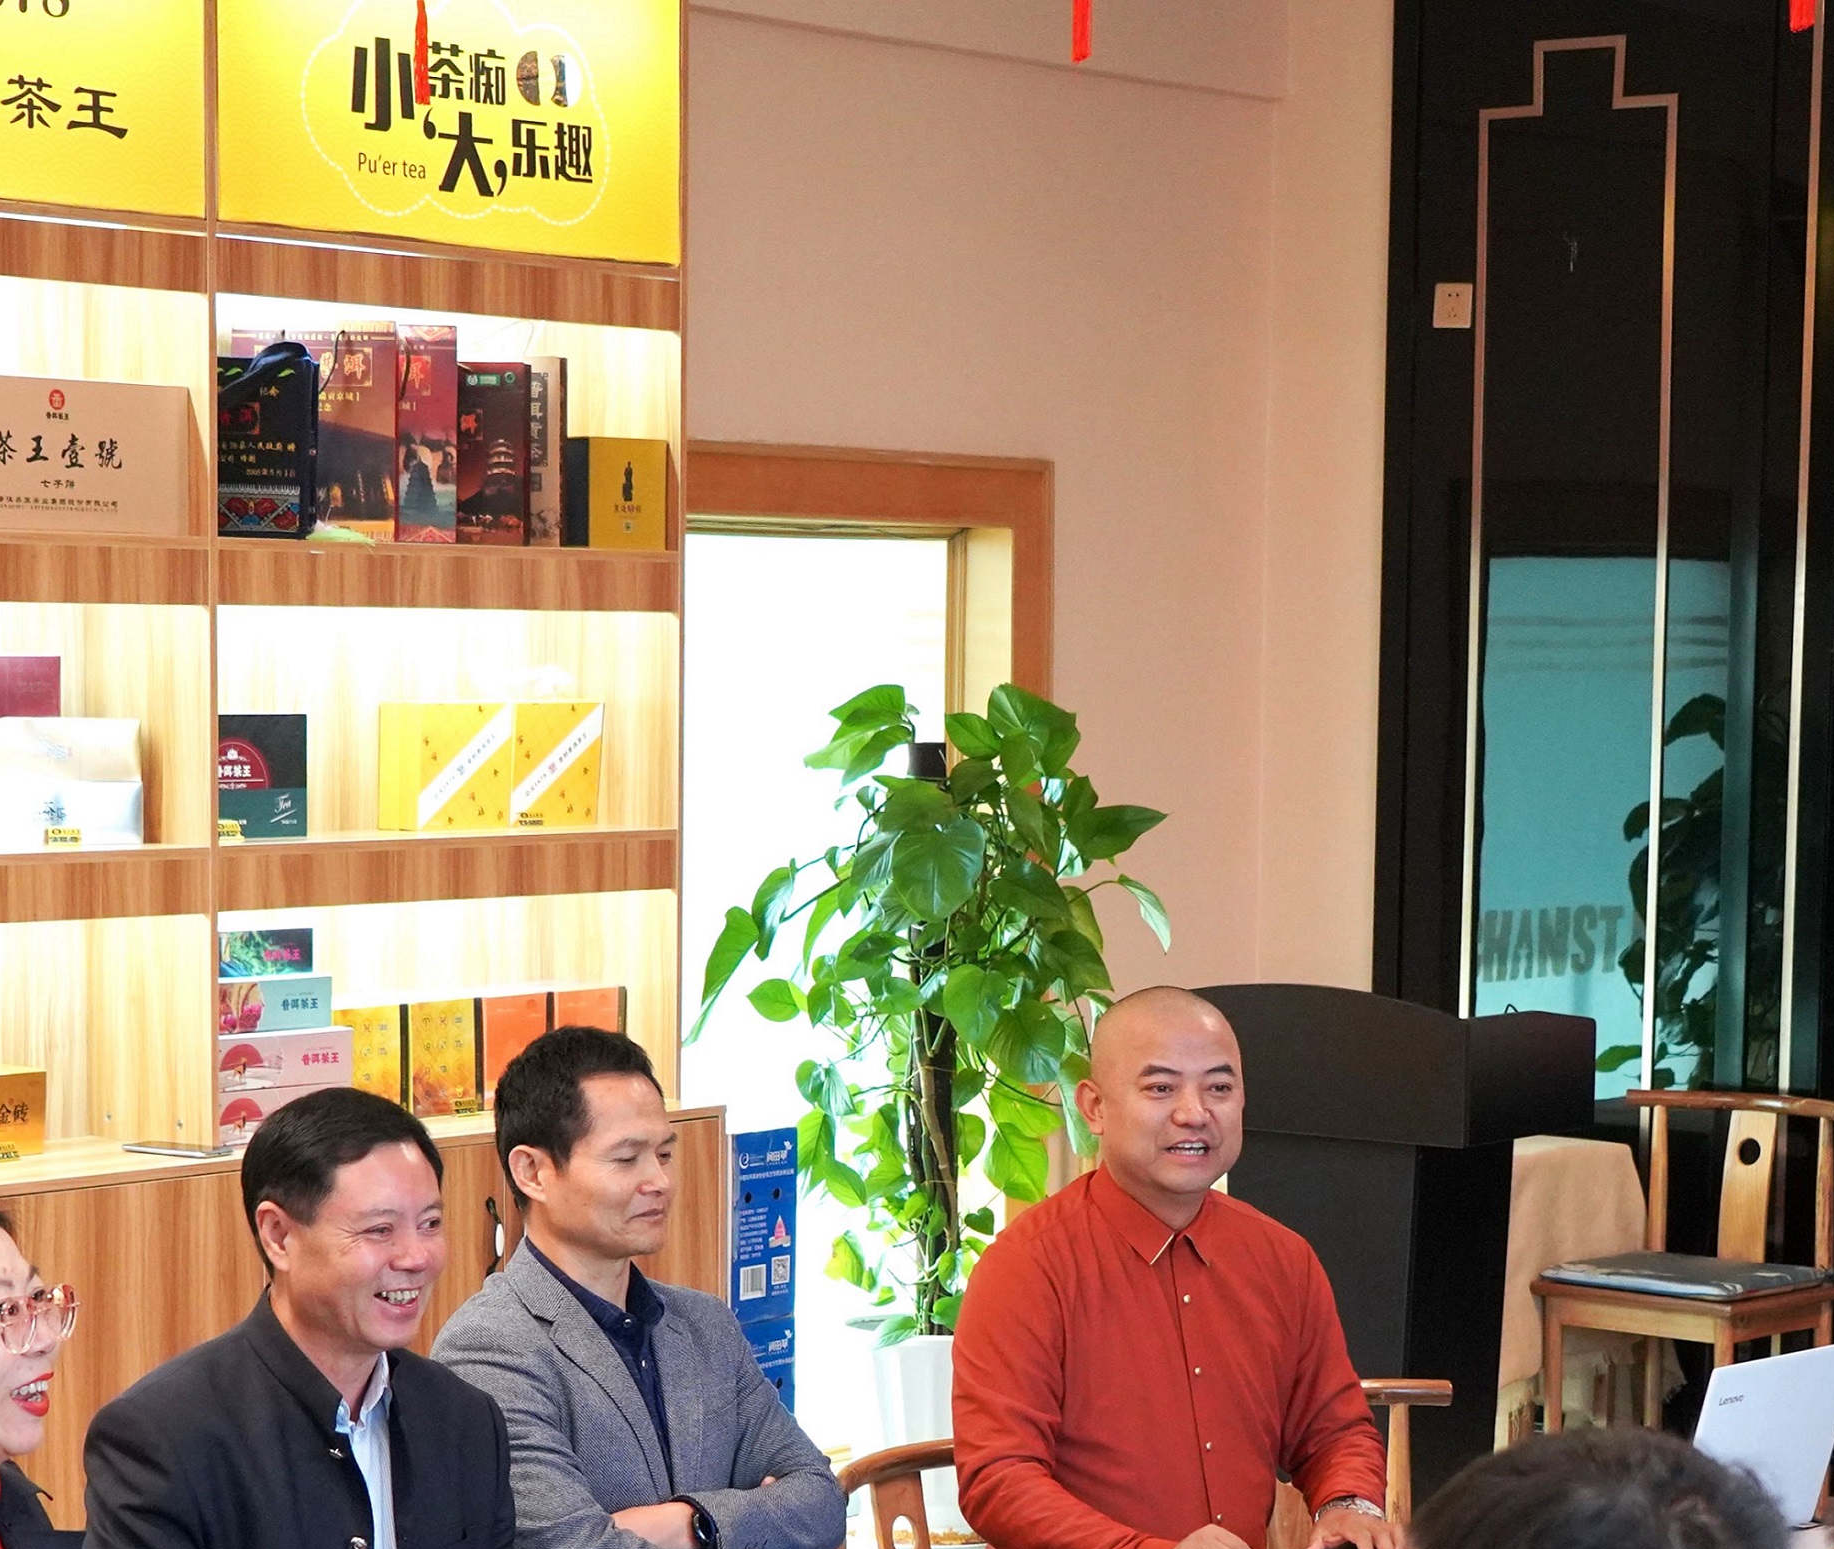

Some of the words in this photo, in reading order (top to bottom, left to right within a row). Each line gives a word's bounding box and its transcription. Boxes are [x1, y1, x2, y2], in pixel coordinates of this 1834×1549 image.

[358, 151, 396, 177] Pu'er
[402, 159, 427, 180] tea
[280, 997, 319, 1012] 普洱茶王
[301, 1051, 340, 1067] 普洱茶王
[1718, 1392, 1745, 1407] Lenovo
